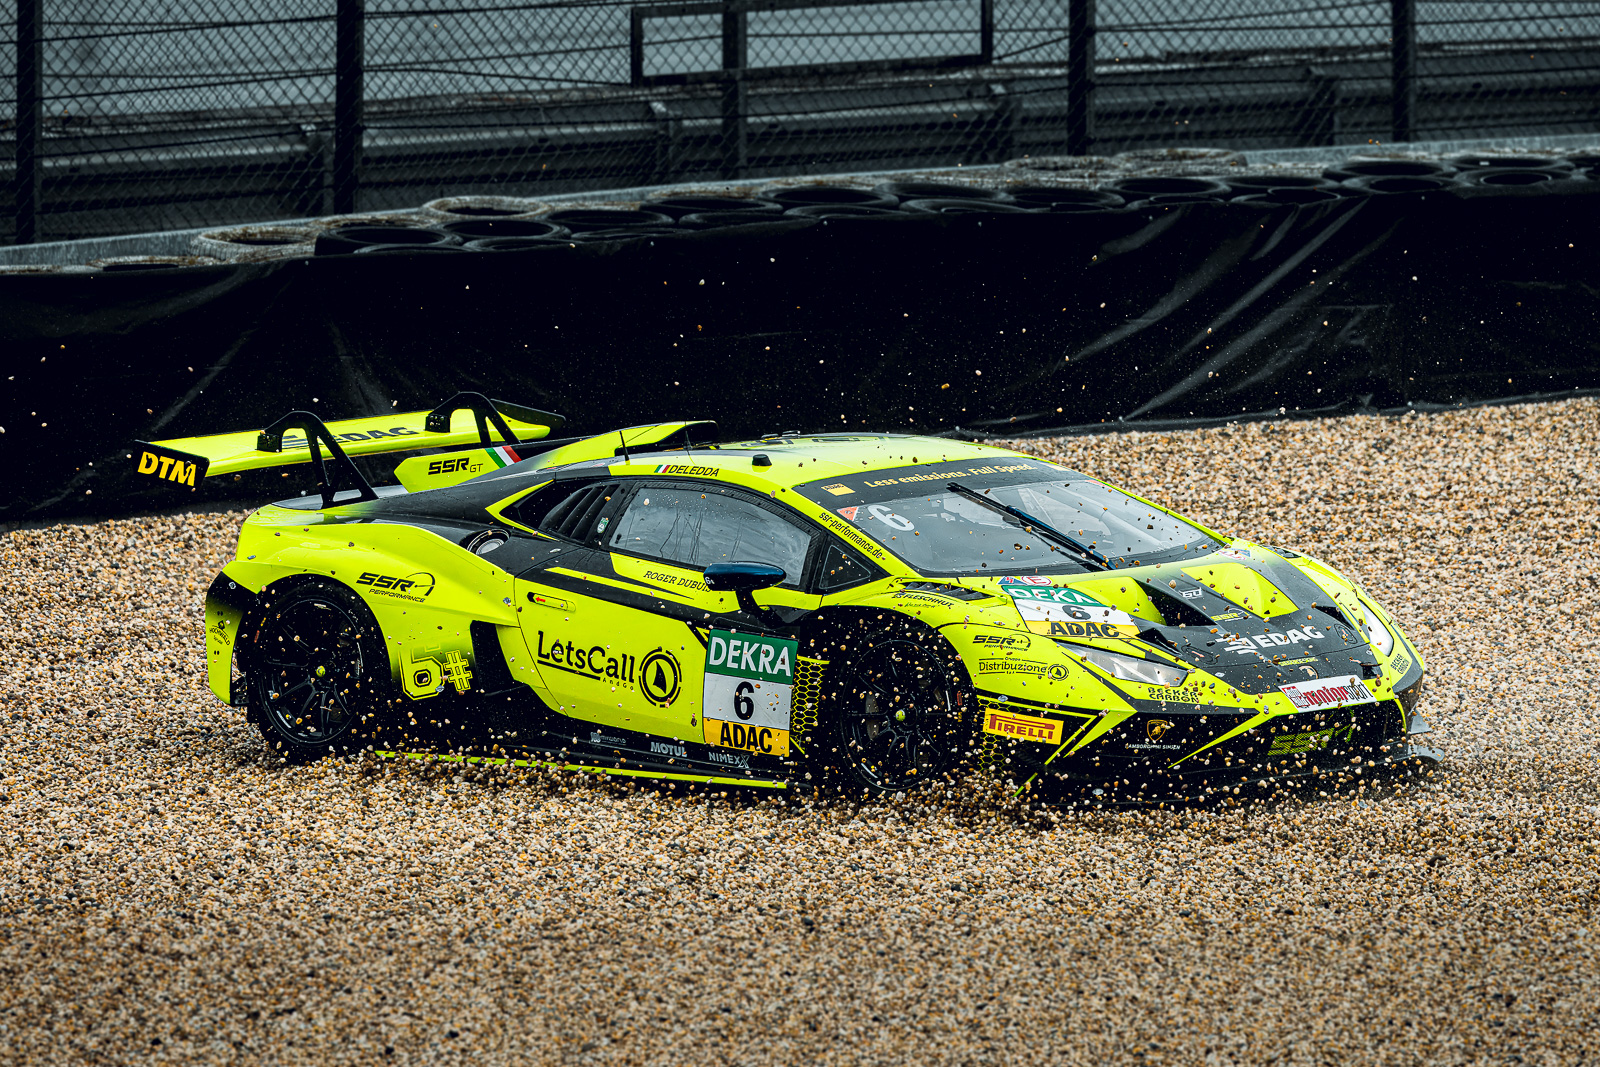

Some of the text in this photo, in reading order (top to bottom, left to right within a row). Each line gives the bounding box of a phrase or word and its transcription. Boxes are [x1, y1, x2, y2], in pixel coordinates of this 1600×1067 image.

[333, 427, 420, 443] DAG
[138, 451, 197, 487] DTM
[428, 457, 483, 476] SSR GT
[668, 464, 720, 477] DELEDDA
[864, 463, 1038, 488] Less emissions. Full Speed.
[867, 504, 915, 531] 6
[819, 512, 883, 559] ssr-performance.de
[356, 571, 416, 593] SSR
[643, 570, 677, 585] ROGER
[368, 588, 426, 603] PERFORMANCE
[1008, 588, 1101, 604] DEK
[1062, 604, 1091, 621] 6
[1050, 622, 1119, 638] ADAC
[1252, 625, 1325, 648] EDAG
[972, 634, 1016, 646] SSR
[537, 630, 635, 684] LetsCall
[708, 636, 792, 677] DEKRA
[979, 661, 1047, 673] Distribuzione
[733, 681, 755, 721] 6
[1147, 686, 1198, 698] BECKER
[1149, 693, 1199, 703] CARBON
[989, 714, 1056, 740] PIRELLI
[720, 722, 773, 754] ADAC
[650, 741, 688, 758] MOTUL
